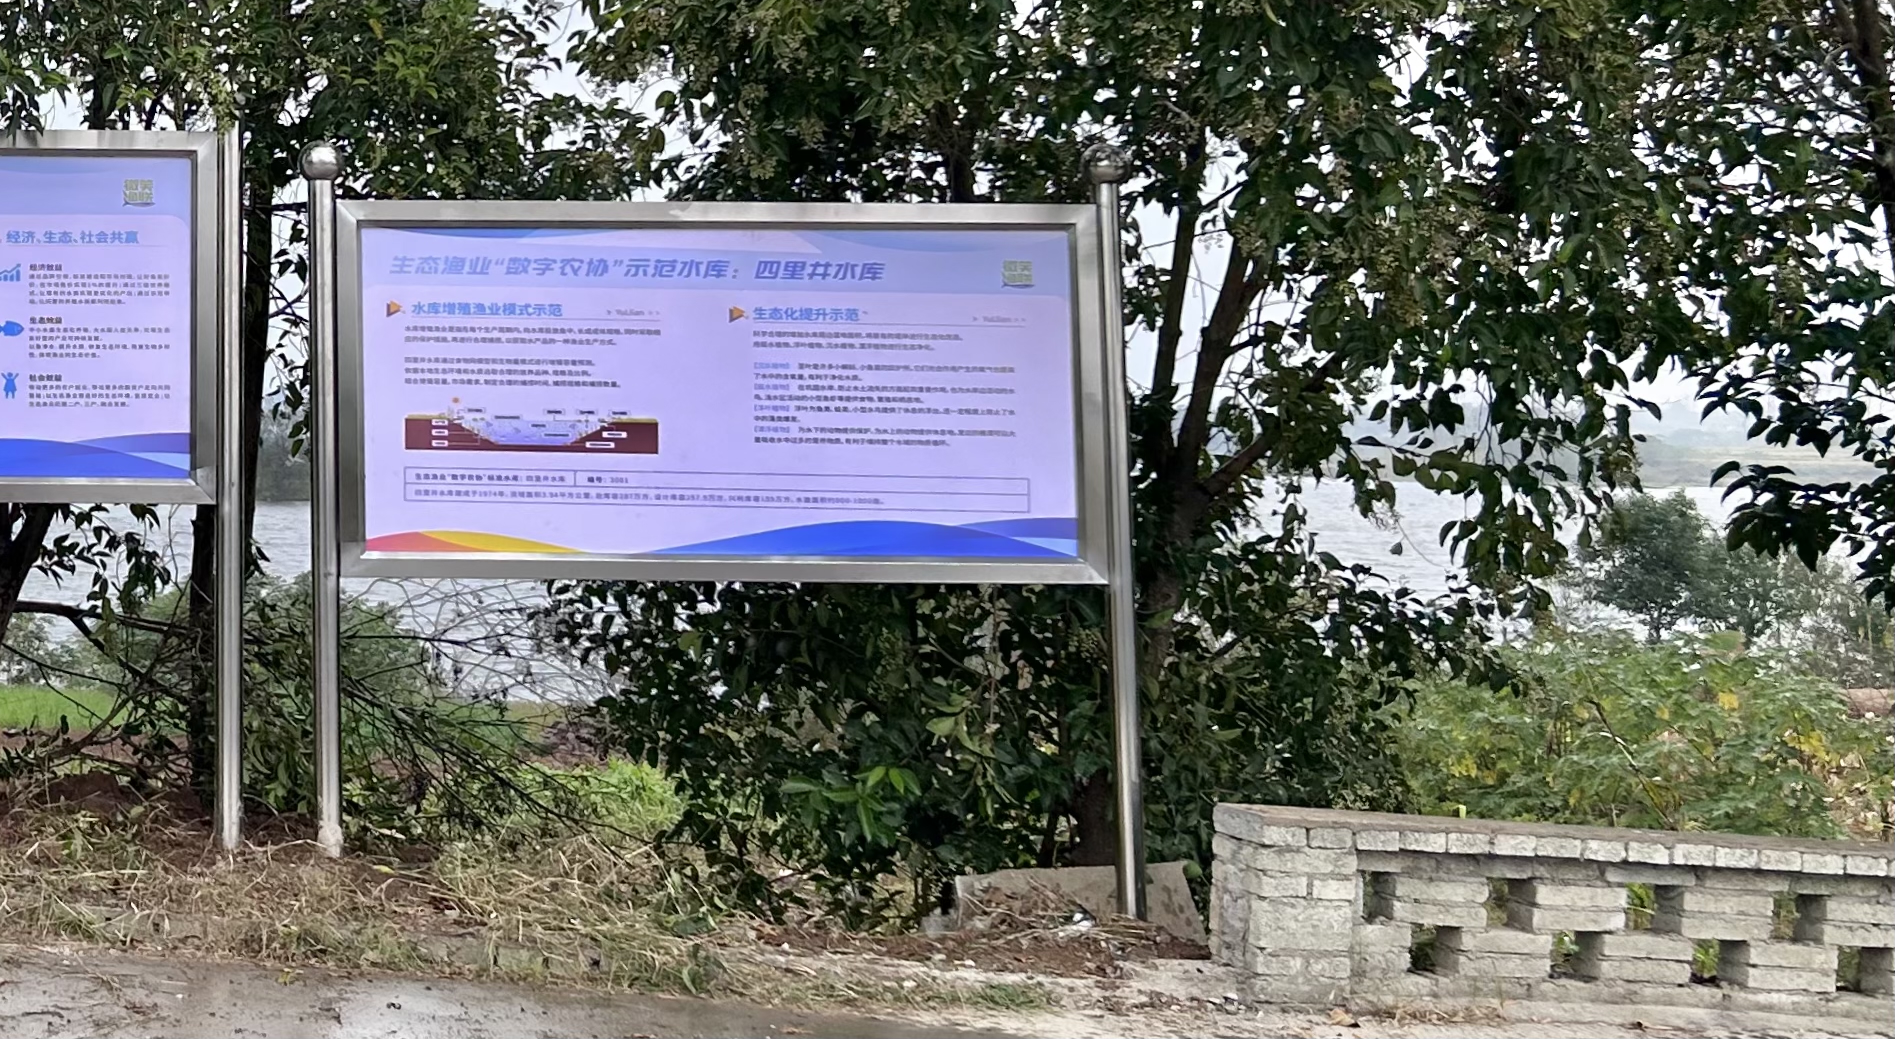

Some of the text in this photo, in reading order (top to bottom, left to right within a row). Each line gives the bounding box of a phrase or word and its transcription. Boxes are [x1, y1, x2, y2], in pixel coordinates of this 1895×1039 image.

[6, 230, 140, 244] 经济、生态、社会共赢
[389, 255, 886, 282] 生态渔业“数字农协”示范水库：四里井水库
[411, 302, 563, 317] 水库增殖渔业模式示范
[753, 307, 860, 322] 生态化提升示范
